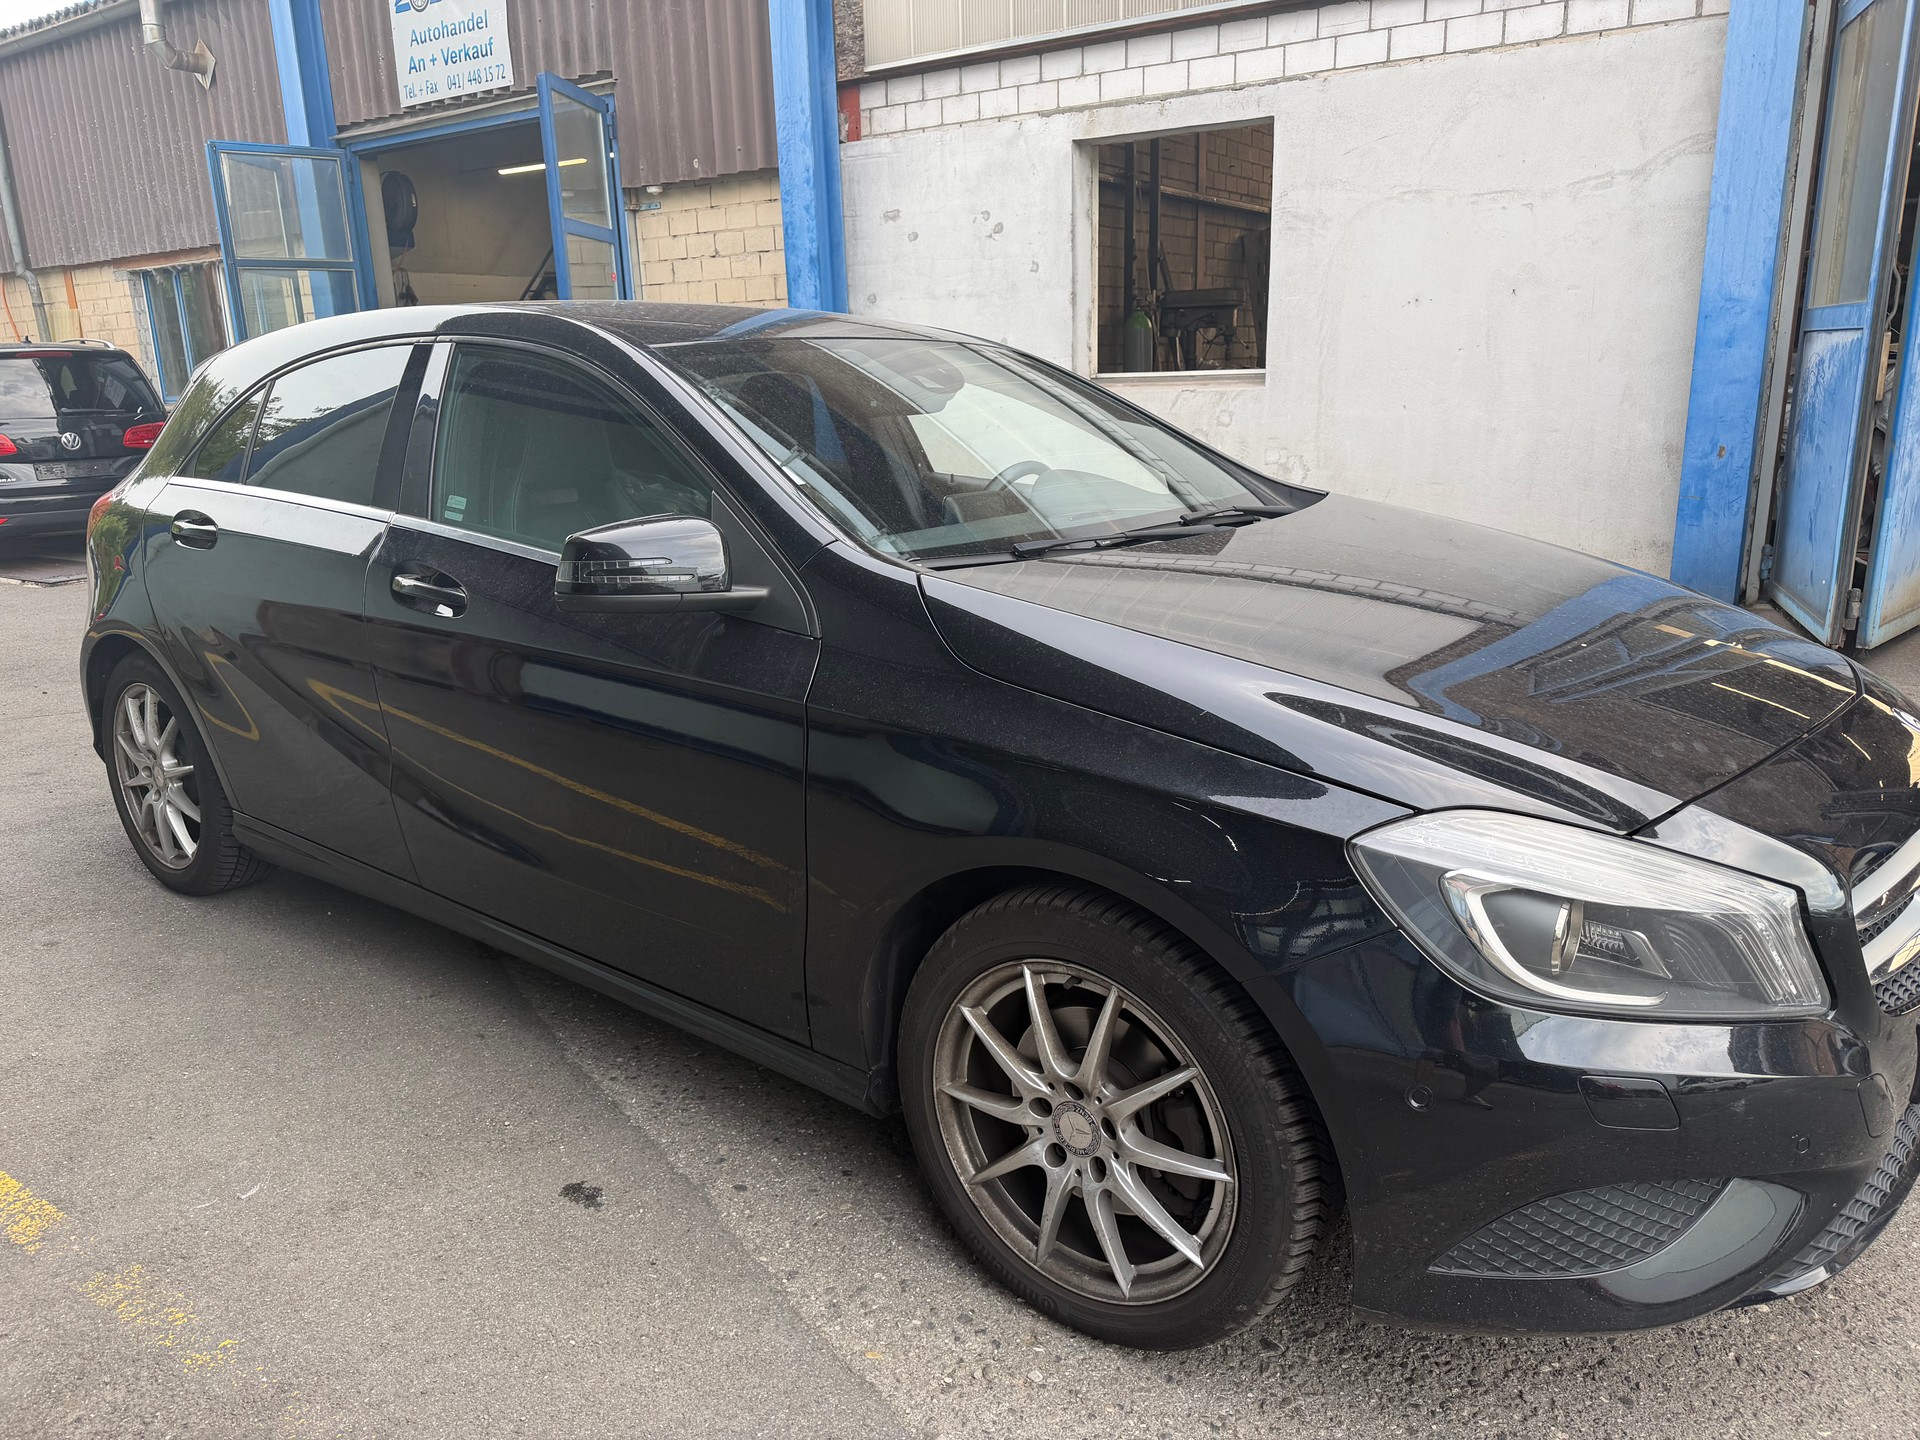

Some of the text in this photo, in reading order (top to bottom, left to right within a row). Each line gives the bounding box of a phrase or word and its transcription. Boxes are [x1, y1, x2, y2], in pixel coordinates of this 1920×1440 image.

[410, 9, 488, 47] Autohandel
[408, 37, 494, 74] An + Verkauf
[403, 82, 417, 99] Tel.
[425, 80, 438, 95] Fax
[467, 68, 482, 86] 448
[484, 66, 494, 83] 15
[495, 63, 506, 80] 72
